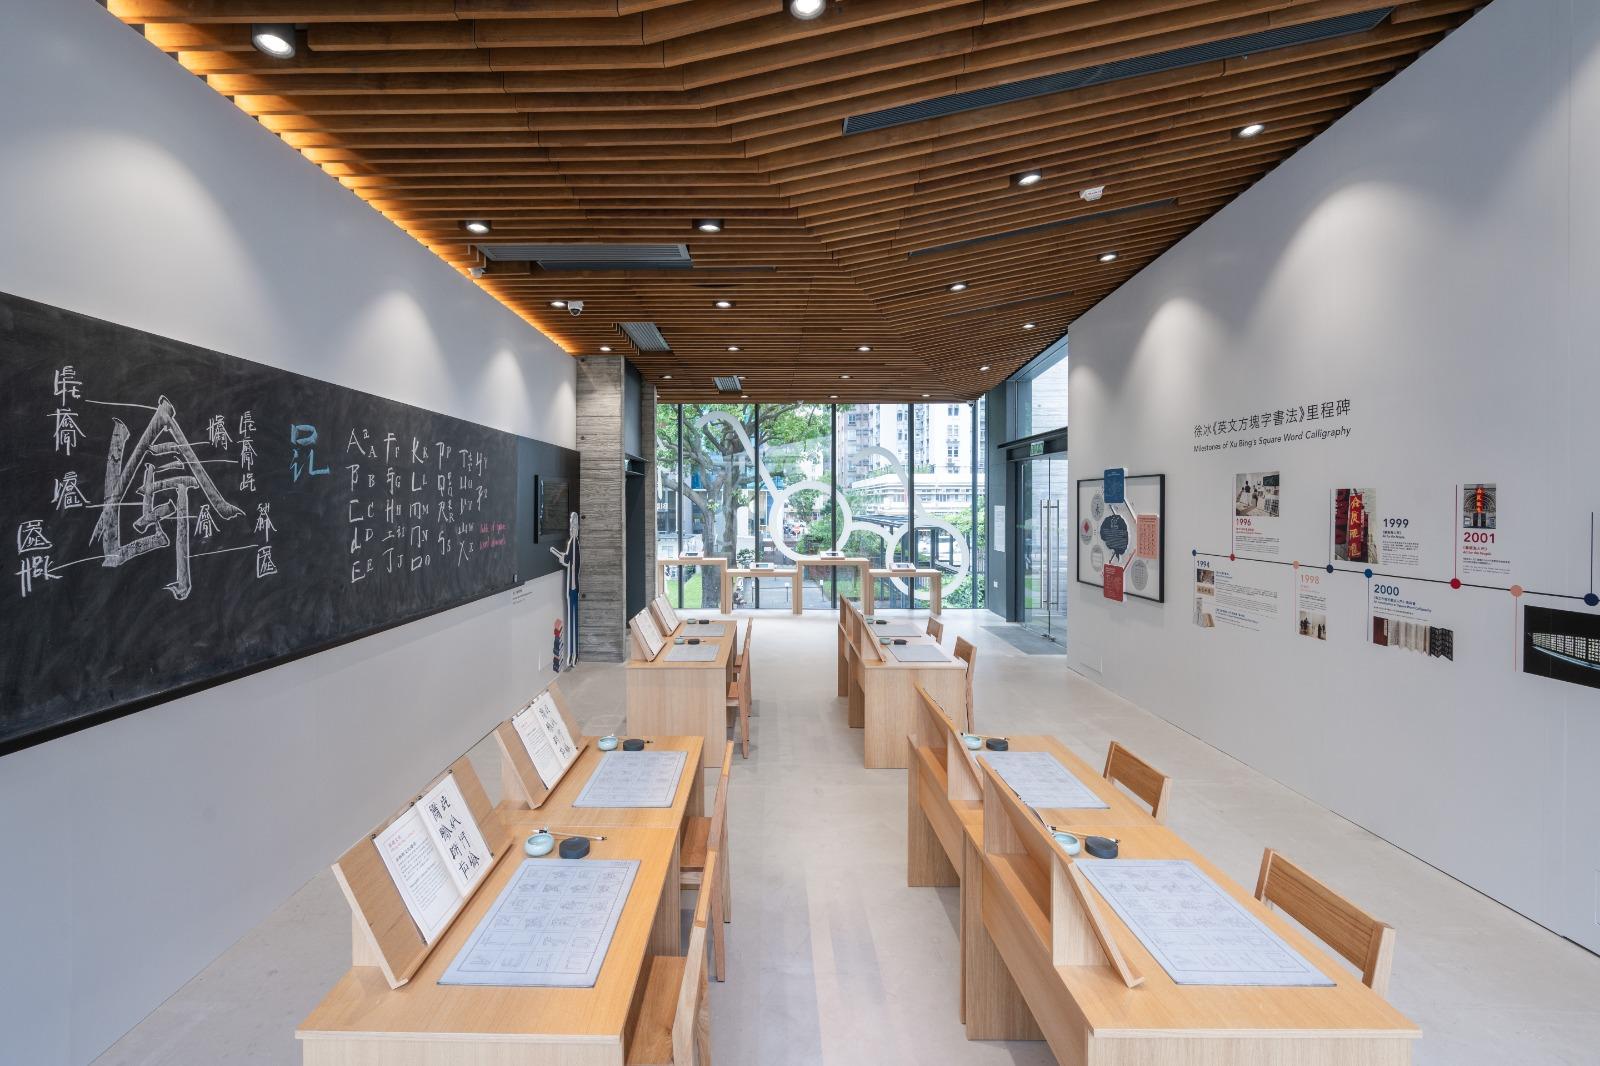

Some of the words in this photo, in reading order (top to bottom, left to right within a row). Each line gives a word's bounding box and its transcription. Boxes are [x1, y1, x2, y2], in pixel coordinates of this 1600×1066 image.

[1194, 399, 1351, 438] 徐冰《英文方塊字書法》里程碑
[1193, 443, 1221, 452] Milestones
[1222, 441, 1229, 449] of
[1229, 440, 1238, 448] Xu
[1238, 438, 1257, 449] Bing's
[1258, 435, 1282, 446] Square
[1283, 431, 1303, 442] Word
[1305, 426, 1352, 440] Calligraphy
[1236, 518, 1252, 526] 1996
[1383, 518, 1409, 529] 1999
[1464, 532, 1495, 544] 2001
[1196, 560, 1210, 568] 1994
[1300, 574, 1320, 585] 1998
[1374, 583, 1400, 596] 2000
